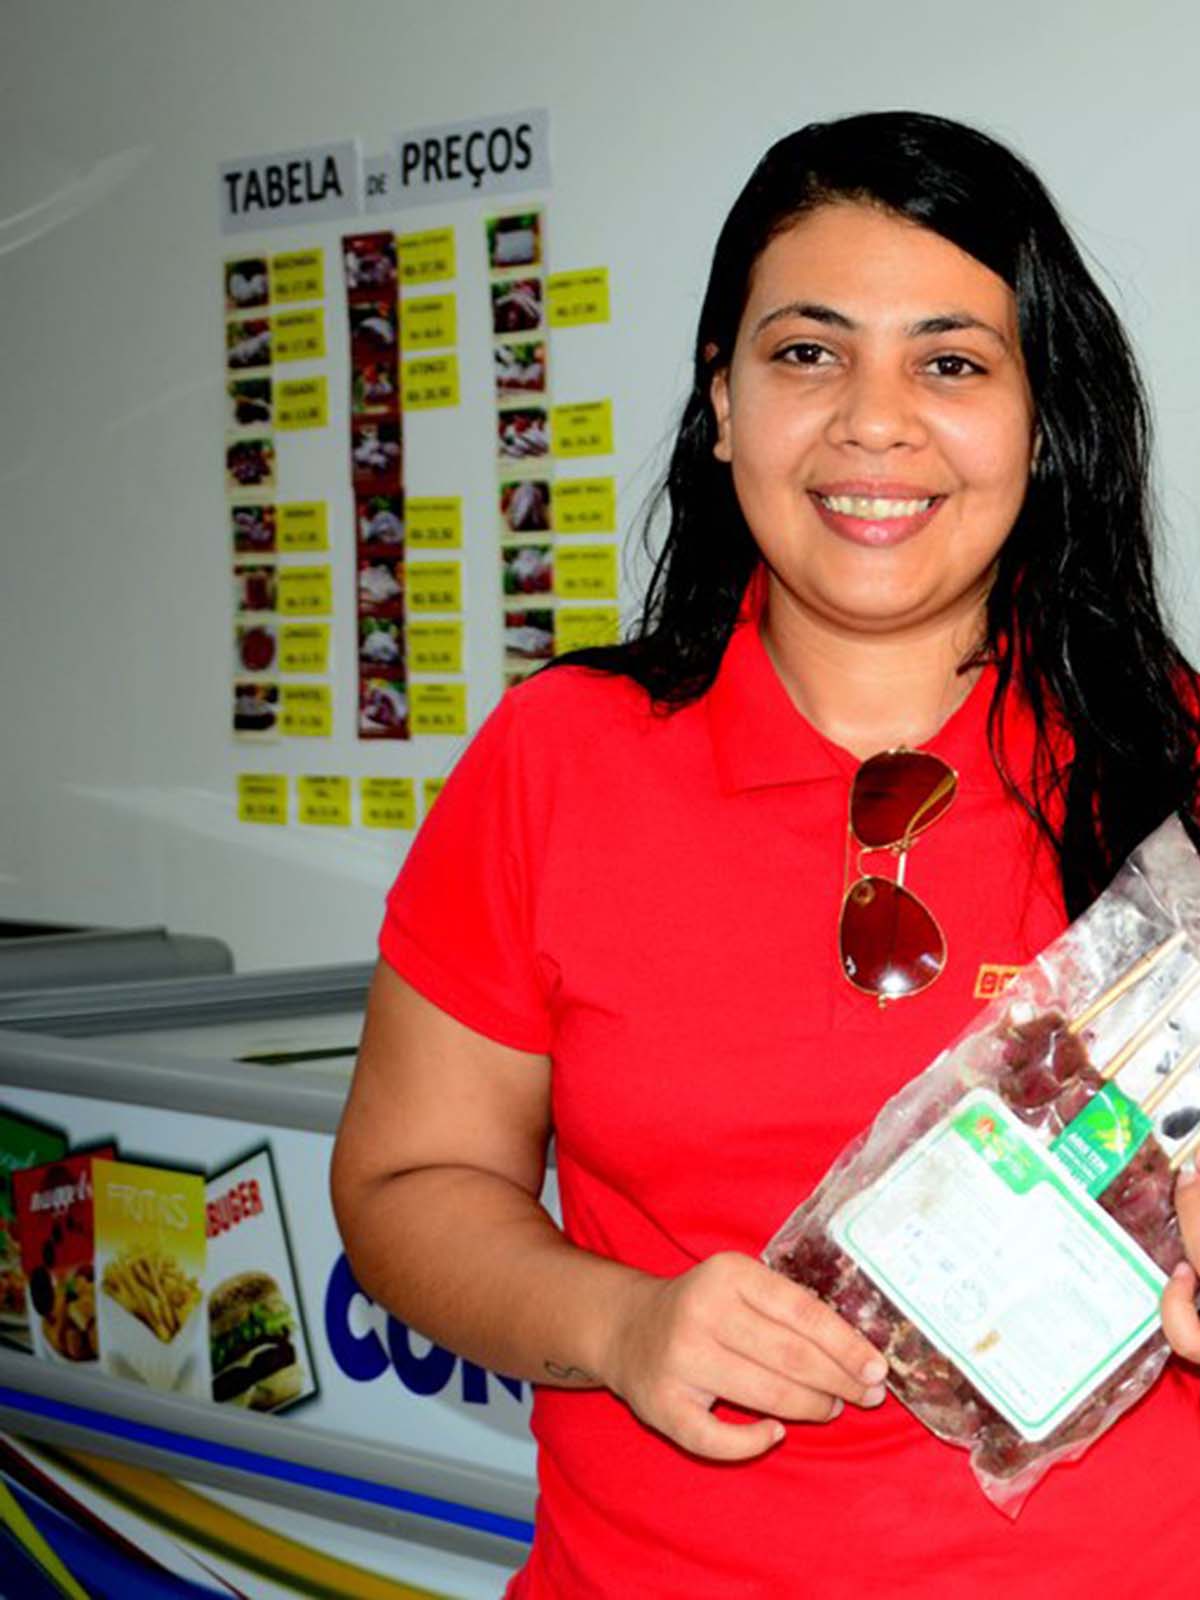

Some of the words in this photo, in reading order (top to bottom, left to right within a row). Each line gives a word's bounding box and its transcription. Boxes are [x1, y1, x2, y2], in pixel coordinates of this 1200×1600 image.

[226, 156, 342, 214] TABELA
[367, 173, 388, 196] DE
[401, 124, 533, 187] PREÇOS
